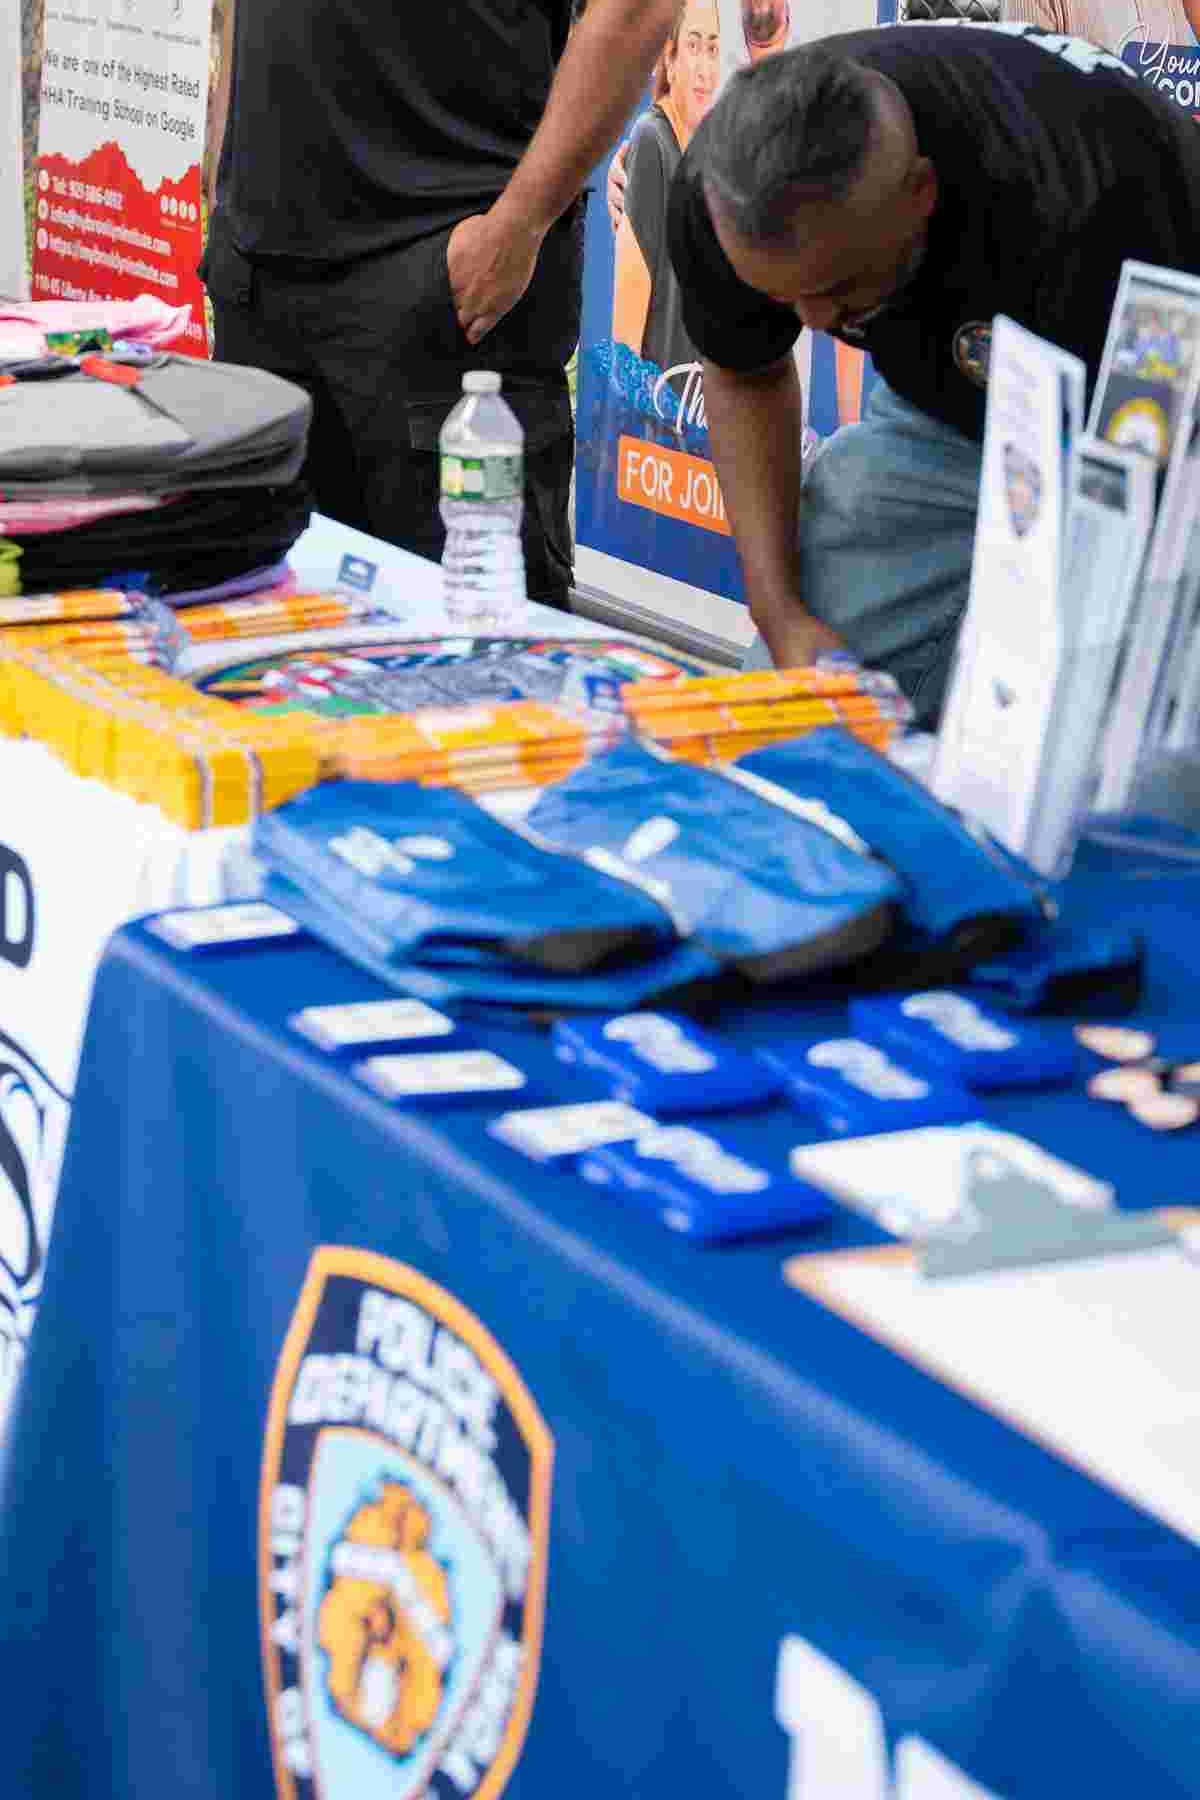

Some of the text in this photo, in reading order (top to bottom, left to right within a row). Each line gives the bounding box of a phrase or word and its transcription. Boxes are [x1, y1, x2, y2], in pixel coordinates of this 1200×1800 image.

[63, 55, 80, 72] are
[102, 58, 116, 79] of
[172, 72, 200, 99] Rated
[113, 98, 144, 127] School
[145, 111, 158, 127] on
[161, 111, 195, 142] Google
[625, 449, 673, 505] FOR
